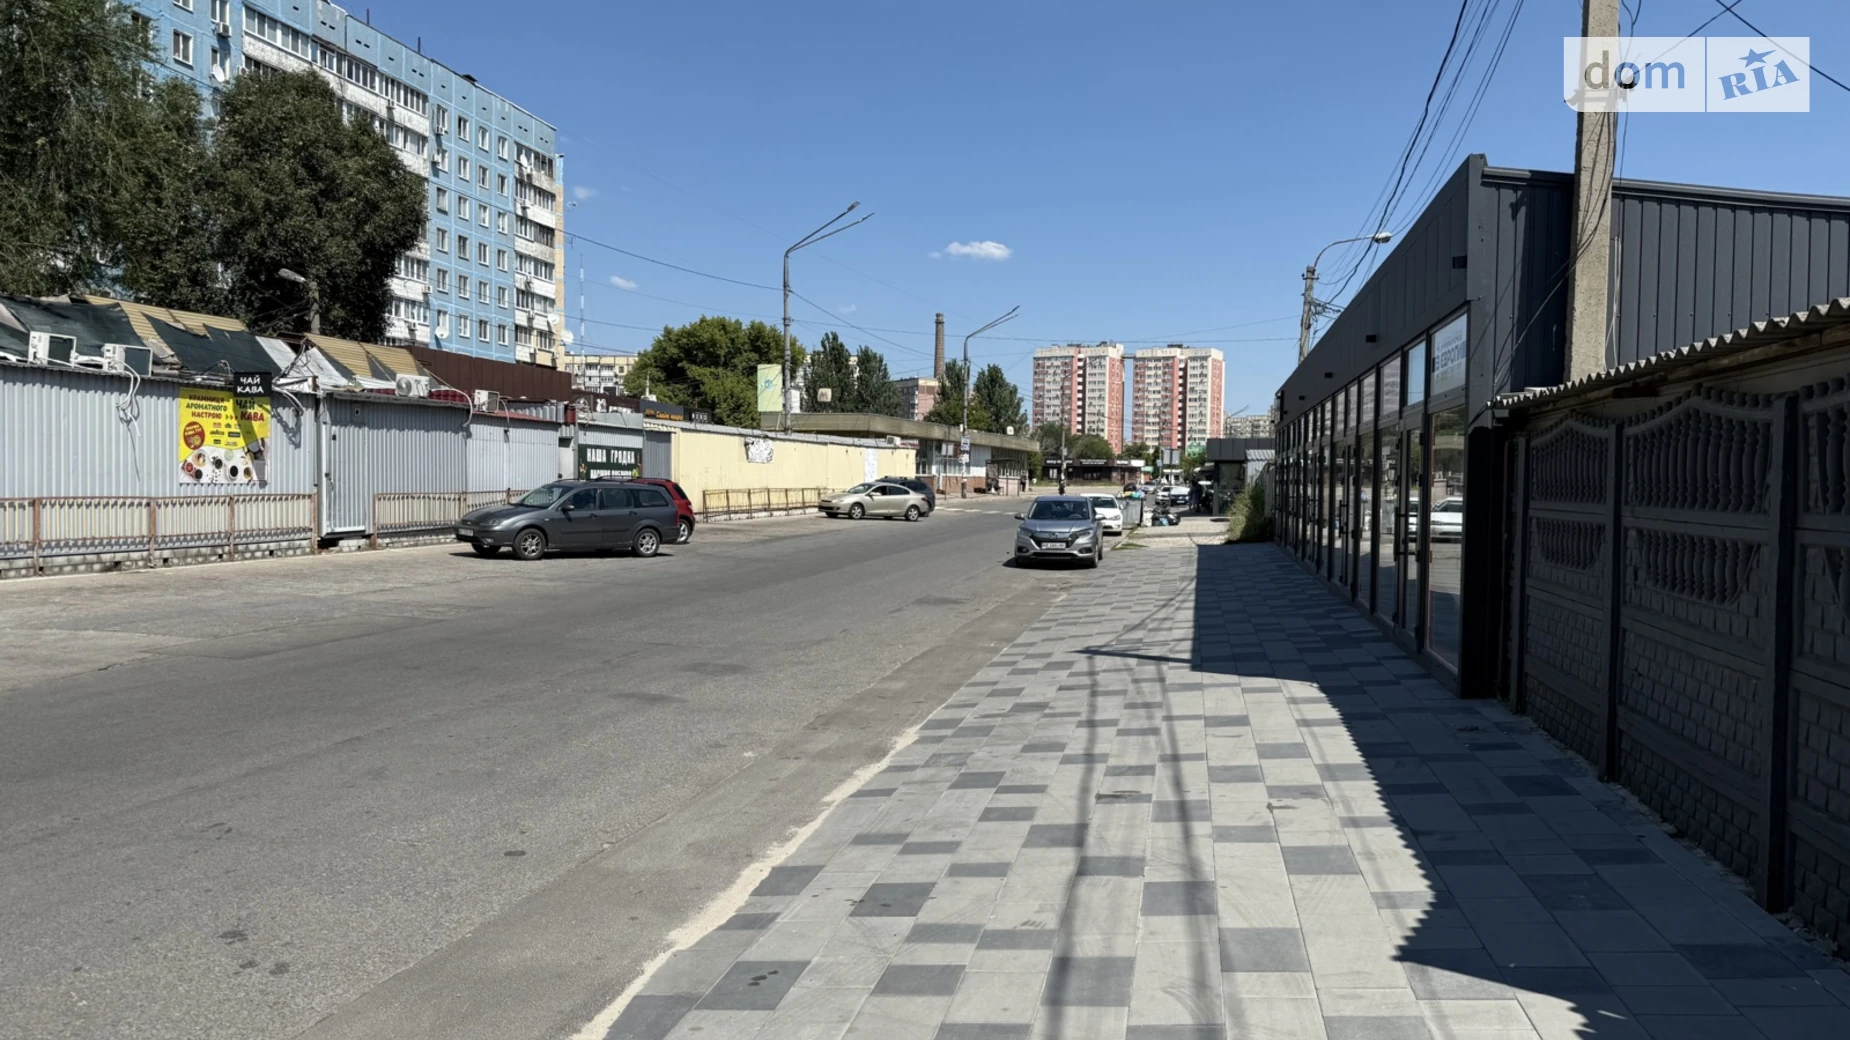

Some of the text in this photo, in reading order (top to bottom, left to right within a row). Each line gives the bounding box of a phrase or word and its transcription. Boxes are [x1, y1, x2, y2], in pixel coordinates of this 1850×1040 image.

[240, 375, 261, 385] ЧАЙ
[237, 386, 264, 394] КАВА
[185, 402, 228, 412] АРОМАТНОГО
[236, 398, 255, 410] ЧАЙ
[191, 412, 222, 420] НАСТРОЮ
[240, 410, 265, 422] КАВА
[586, 448, 636, 466] НАША ГРЯДКА
